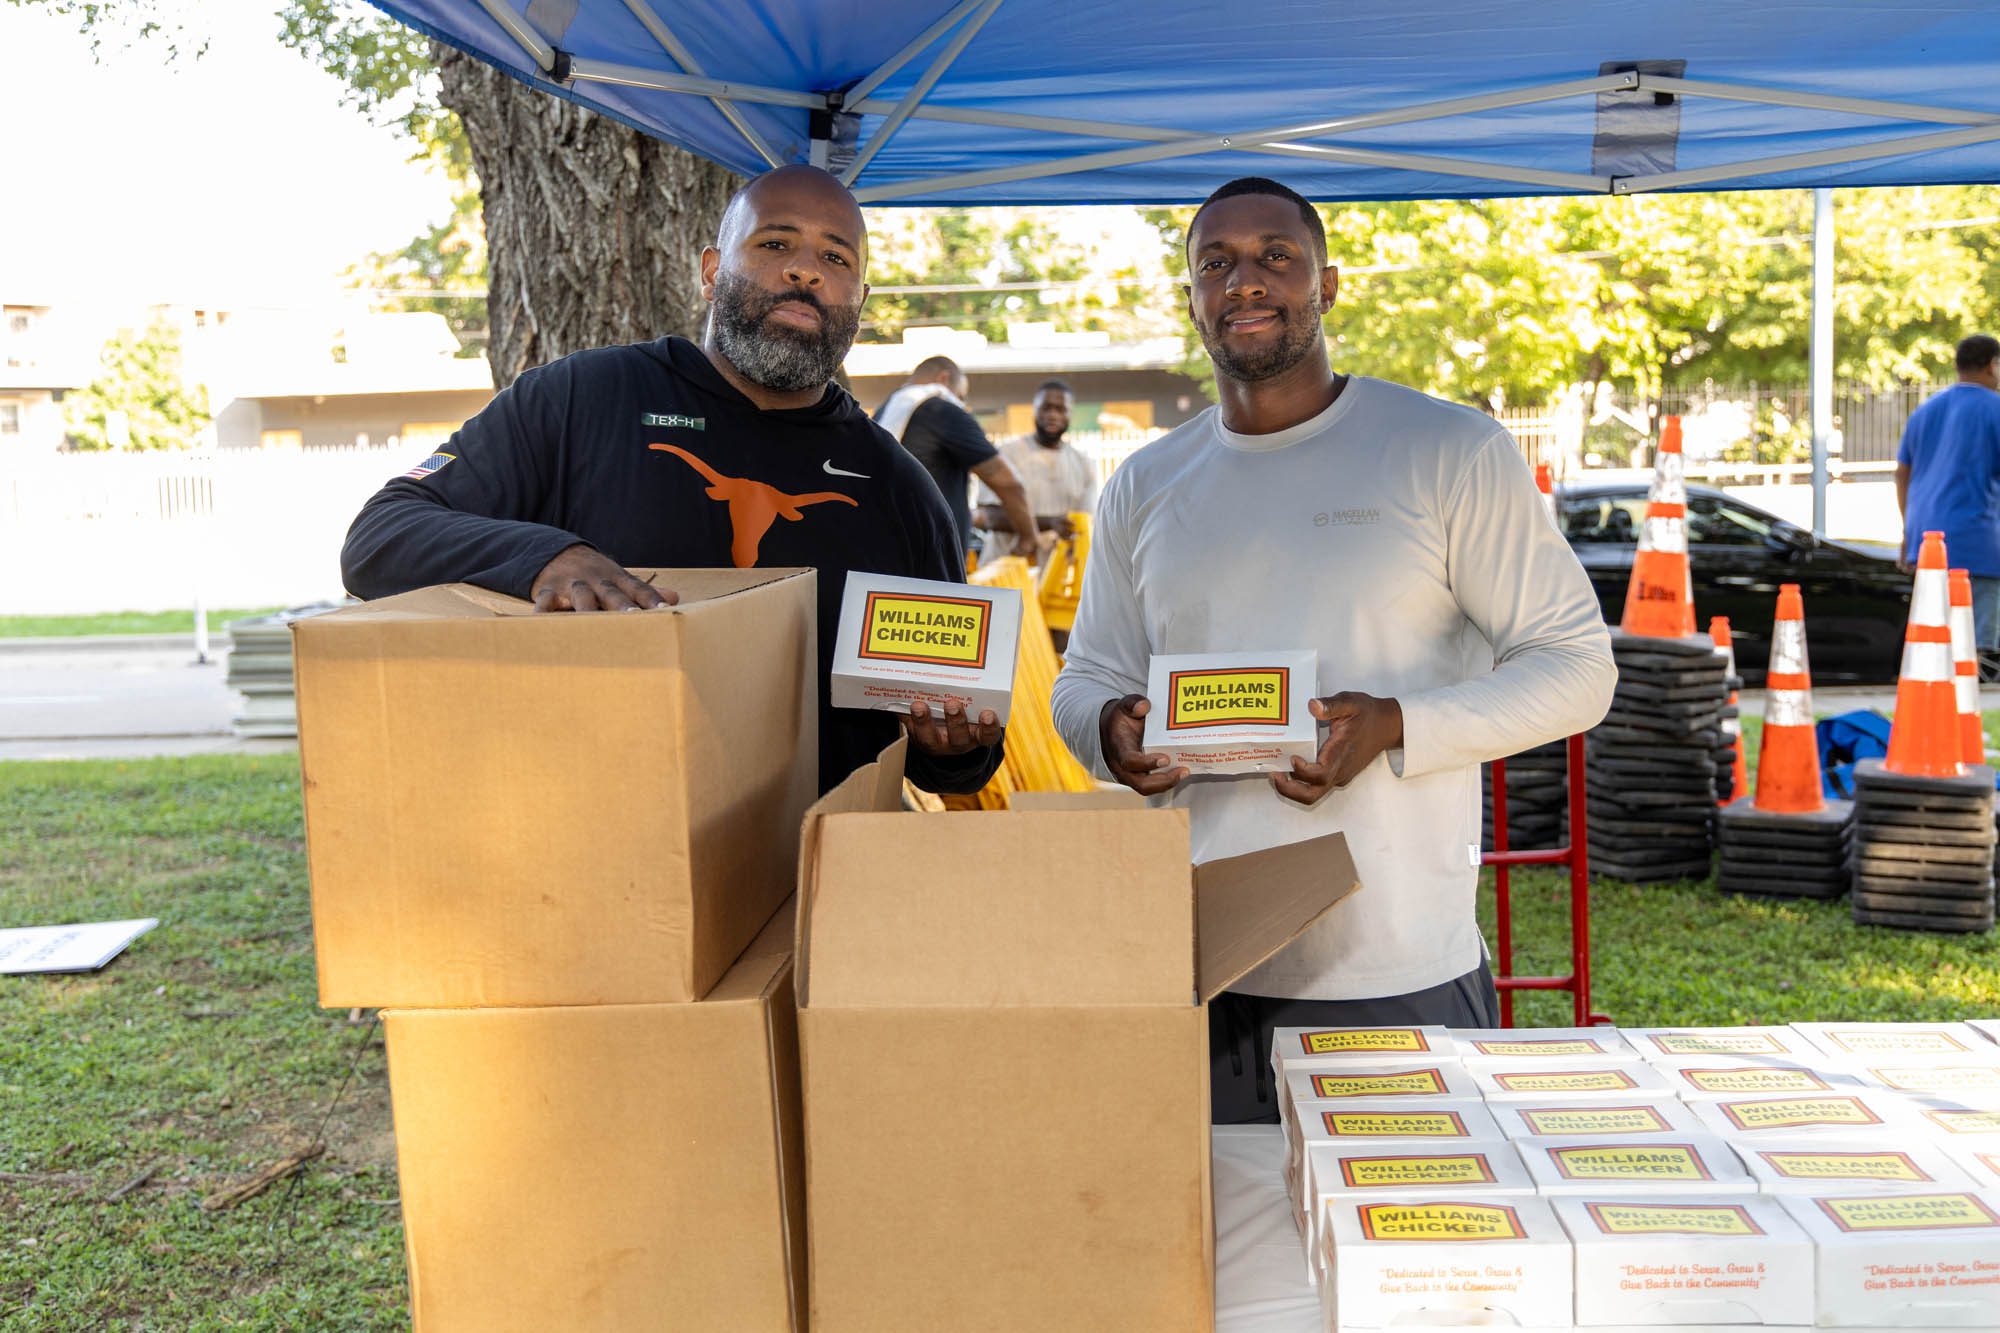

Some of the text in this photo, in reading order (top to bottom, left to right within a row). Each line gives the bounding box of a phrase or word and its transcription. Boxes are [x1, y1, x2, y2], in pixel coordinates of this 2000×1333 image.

[650, 414, 694, 428] TEX-H
[879, 610, 976, 630] WILLIAMS
[1182, 683, 1276, 697] WILLIAMS
[1316, 1033, 1410, 1044] WILLIAMS
[1318, 1040, 1406, 1048] CHICKEN
[1512, 1075, 1615, 1085] WILLIAMS
[1702, 1072, 1805, 1082] WILLIAMS
[1328, 1078, 1429, 1088] WILLIAMS
[1330, 1083, 1424, 1093] CHICKEN
[1740, 1104, 1852, 1114] WILLIAMS
[1538, 1114, 1645, 1122] WILLIAMS
[1748, 1111, 1851, 1121] CHICKEN
[1544, 1121, 1644, 1129] CHICKEN
[1568, 1154, 1686, 1164] WILLIAMS
[1358, 1164, 1473, 1173] WILLIAMS
[1574, 1165, 1683, 1174] CHICKEN
[1782, 1160, 1900, 1169] WILLIAMS
[1361, 1171, 1468, 1180] CHICKEN
[1840, 1200, 1968, 1212] WILLIAMS
[1378, 1210, 1502, 1223] WILLIAMS
[1608, 1211, 1734, 1222] WILLIAMS
[1850, 1210, 1969, 1220] CHICKEN
[1382, 1222, 1496, 1233] CHICKEN
[1615, 1218, 1733, 1230] CHICKEN
[1679, 1264, 1688, 1274] to
[1757, 1262, 1765, 1273] &
[1645, 1278, 1670, 1289] Back
[1673, 1278, 1682, 1289] to
[1686, 1278, 1702, 1288] the
[1889, 1278, 1915, 1288] Back
[1930, 1276, 1946, 1287] the
